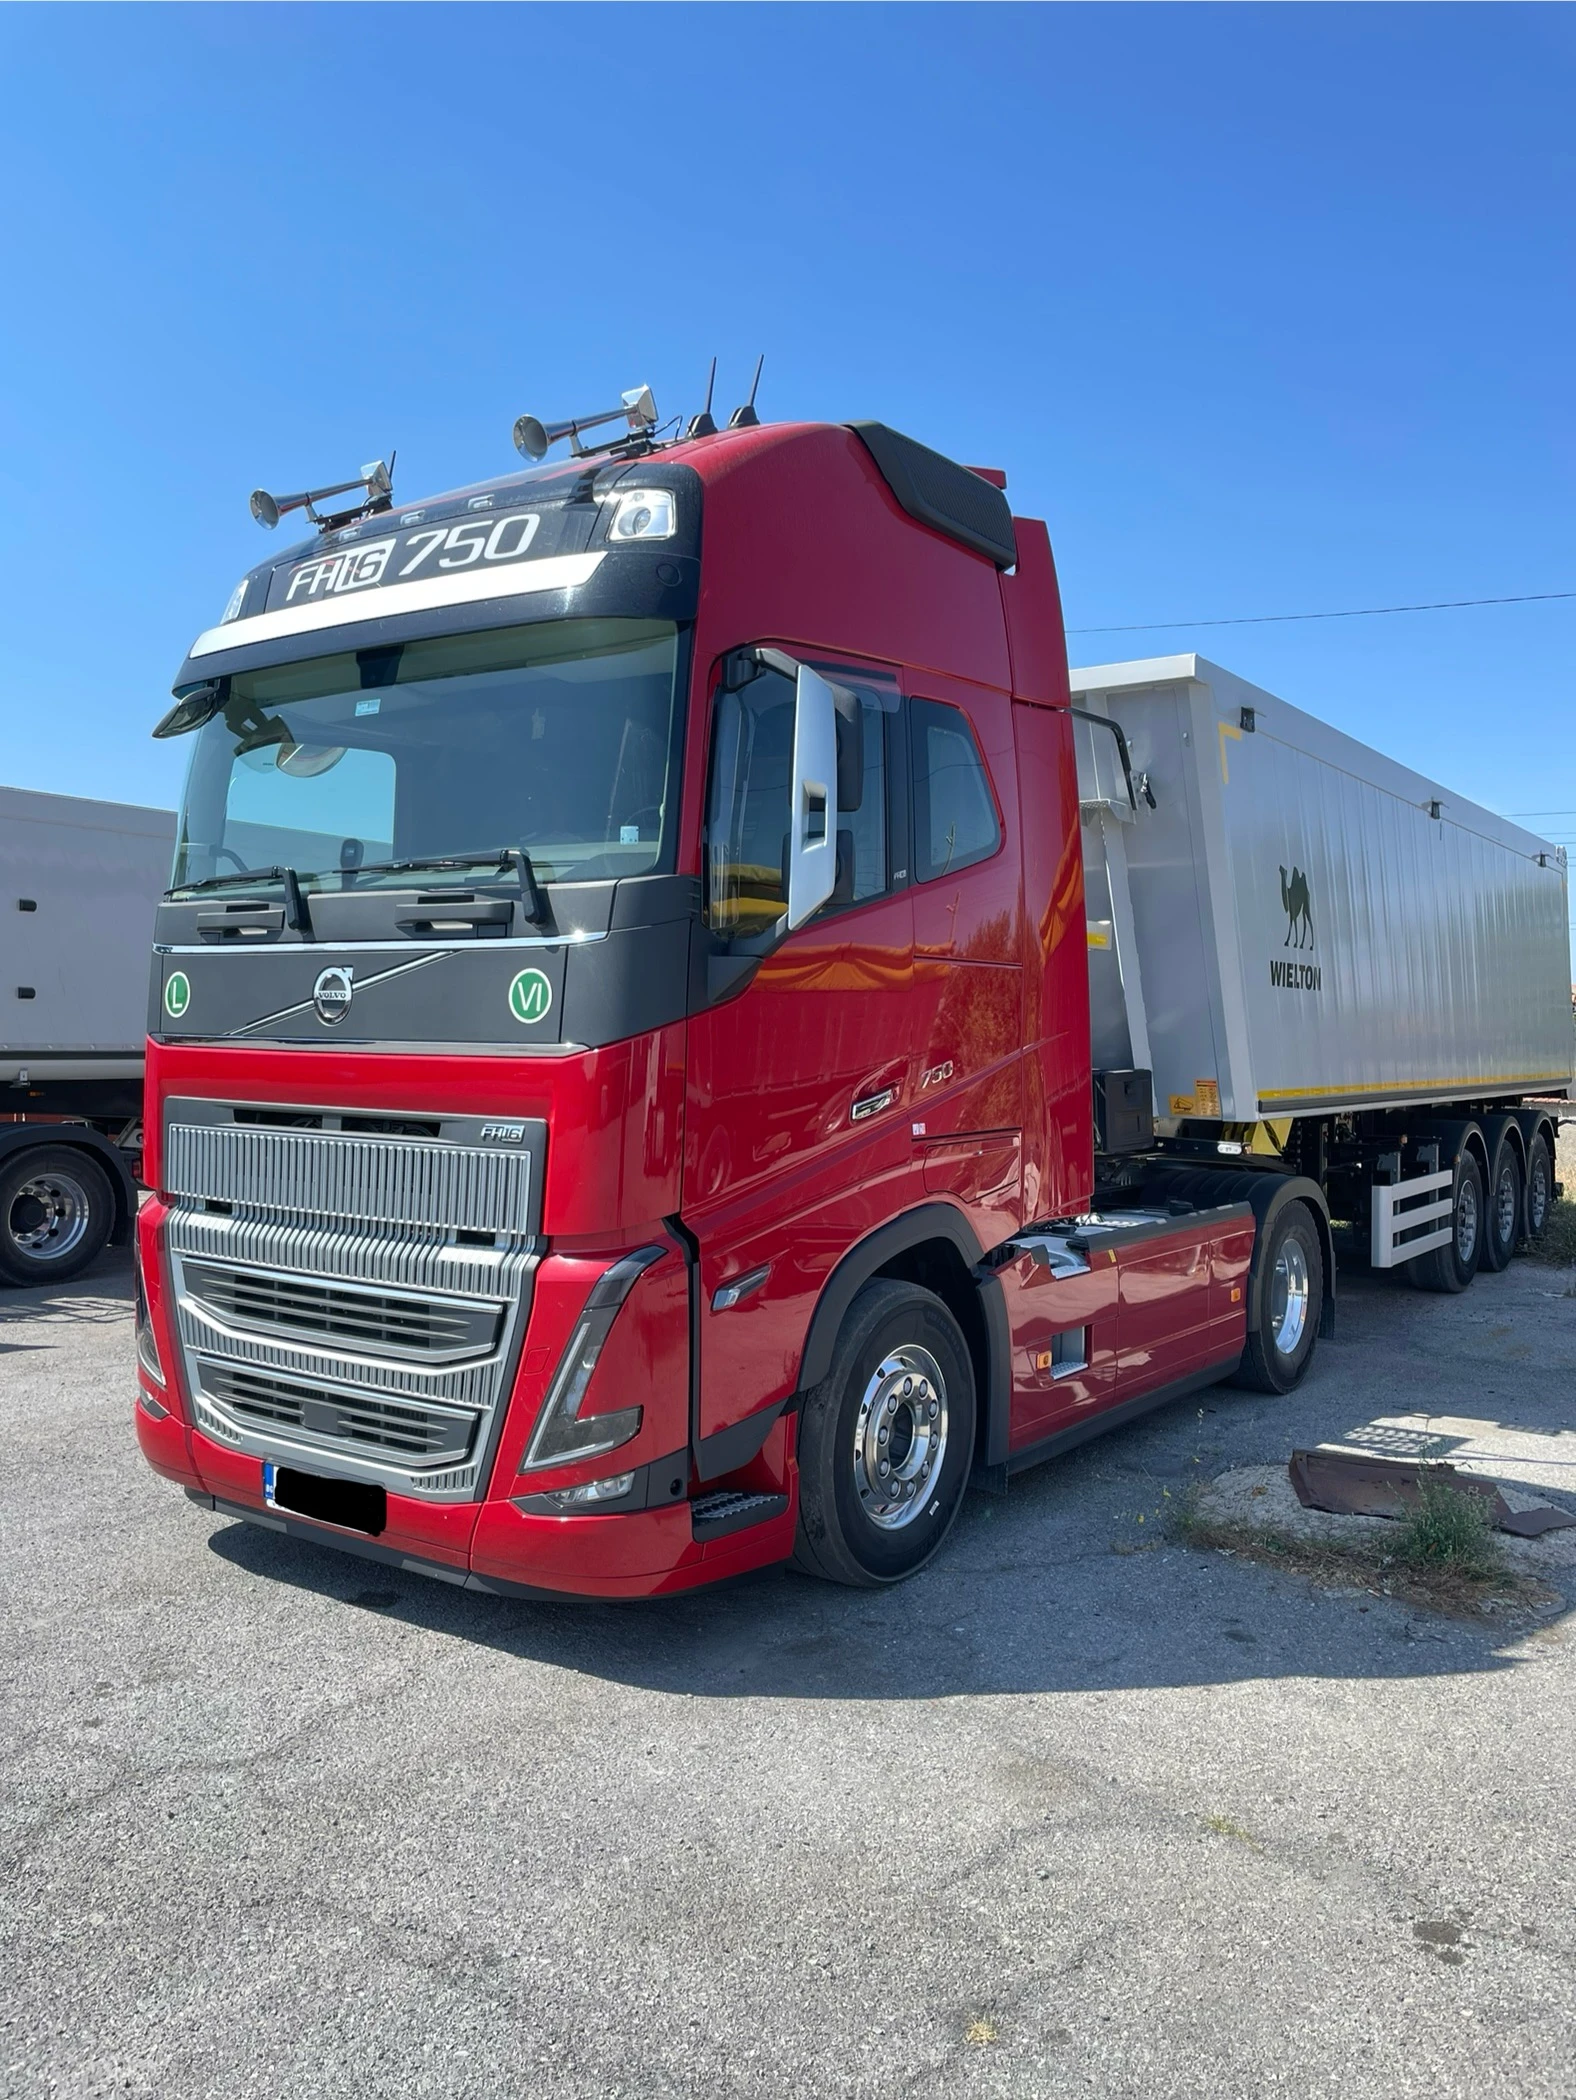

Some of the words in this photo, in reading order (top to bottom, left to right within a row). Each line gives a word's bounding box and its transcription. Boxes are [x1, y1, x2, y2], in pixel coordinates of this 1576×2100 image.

[286, 538, 397, 601] FH16
[399, 514, 541, 576] 750
[1270, 960, 1321, 991] WIELTON
[172, 981, 183, 1008] L
[317, 991, 347, 999] VOLVO
[517, 981, 543, 1012] VI
[921, 1060, 954, 1089] 750
[480, 1123, 525, 1144] FH16
